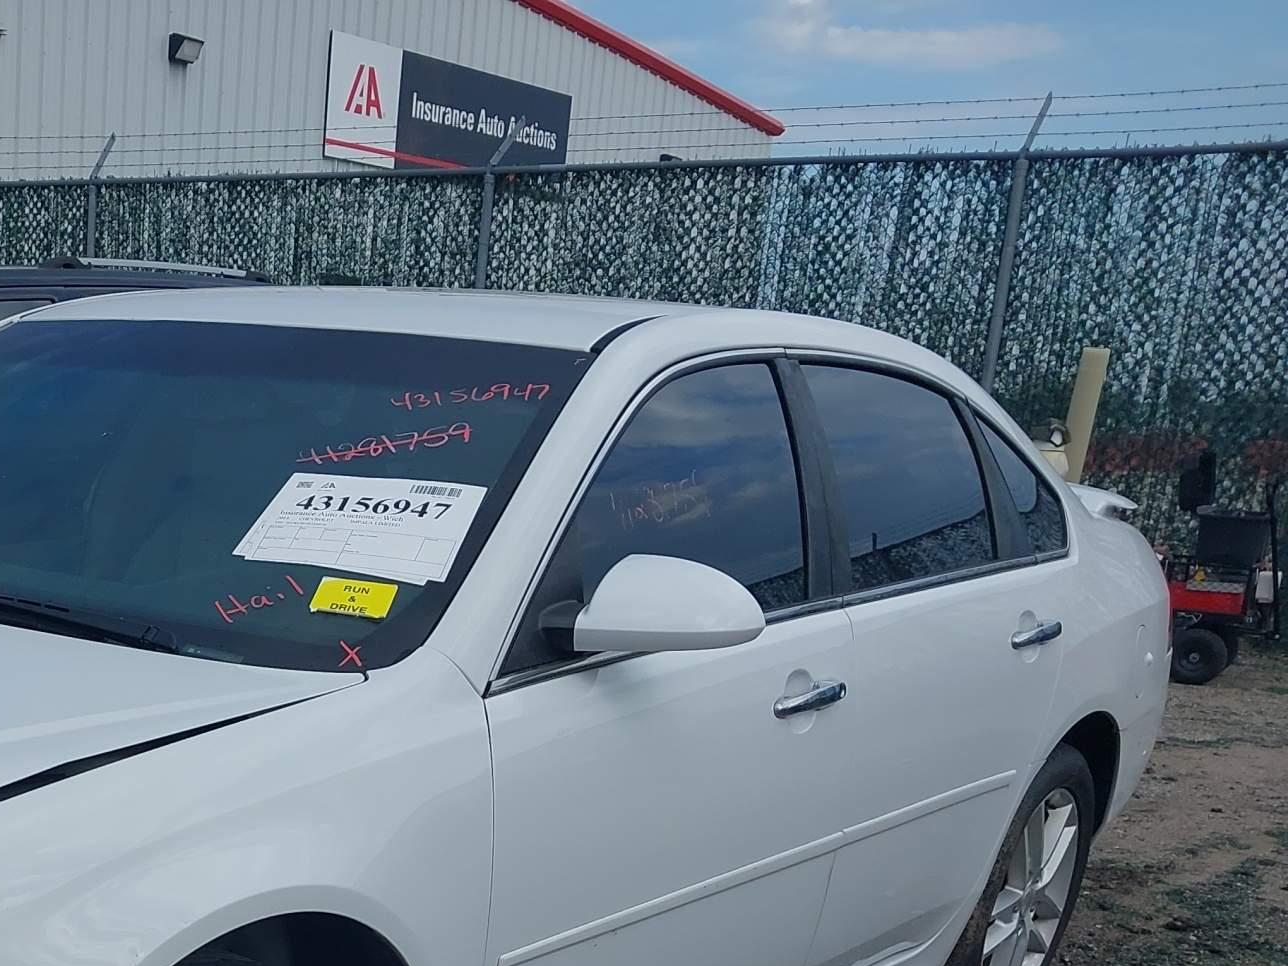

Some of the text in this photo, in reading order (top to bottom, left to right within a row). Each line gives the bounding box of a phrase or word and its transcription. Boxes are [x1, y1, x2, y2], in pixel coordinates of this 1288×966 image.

[412, 92, 475, 129] Insurance
[477, 107, 505, 138] Auto
[295, 495, 453, 520] 43156947
[343, 585, 371, 595] RUN
[329, 602, 368, 614] DRIVE
